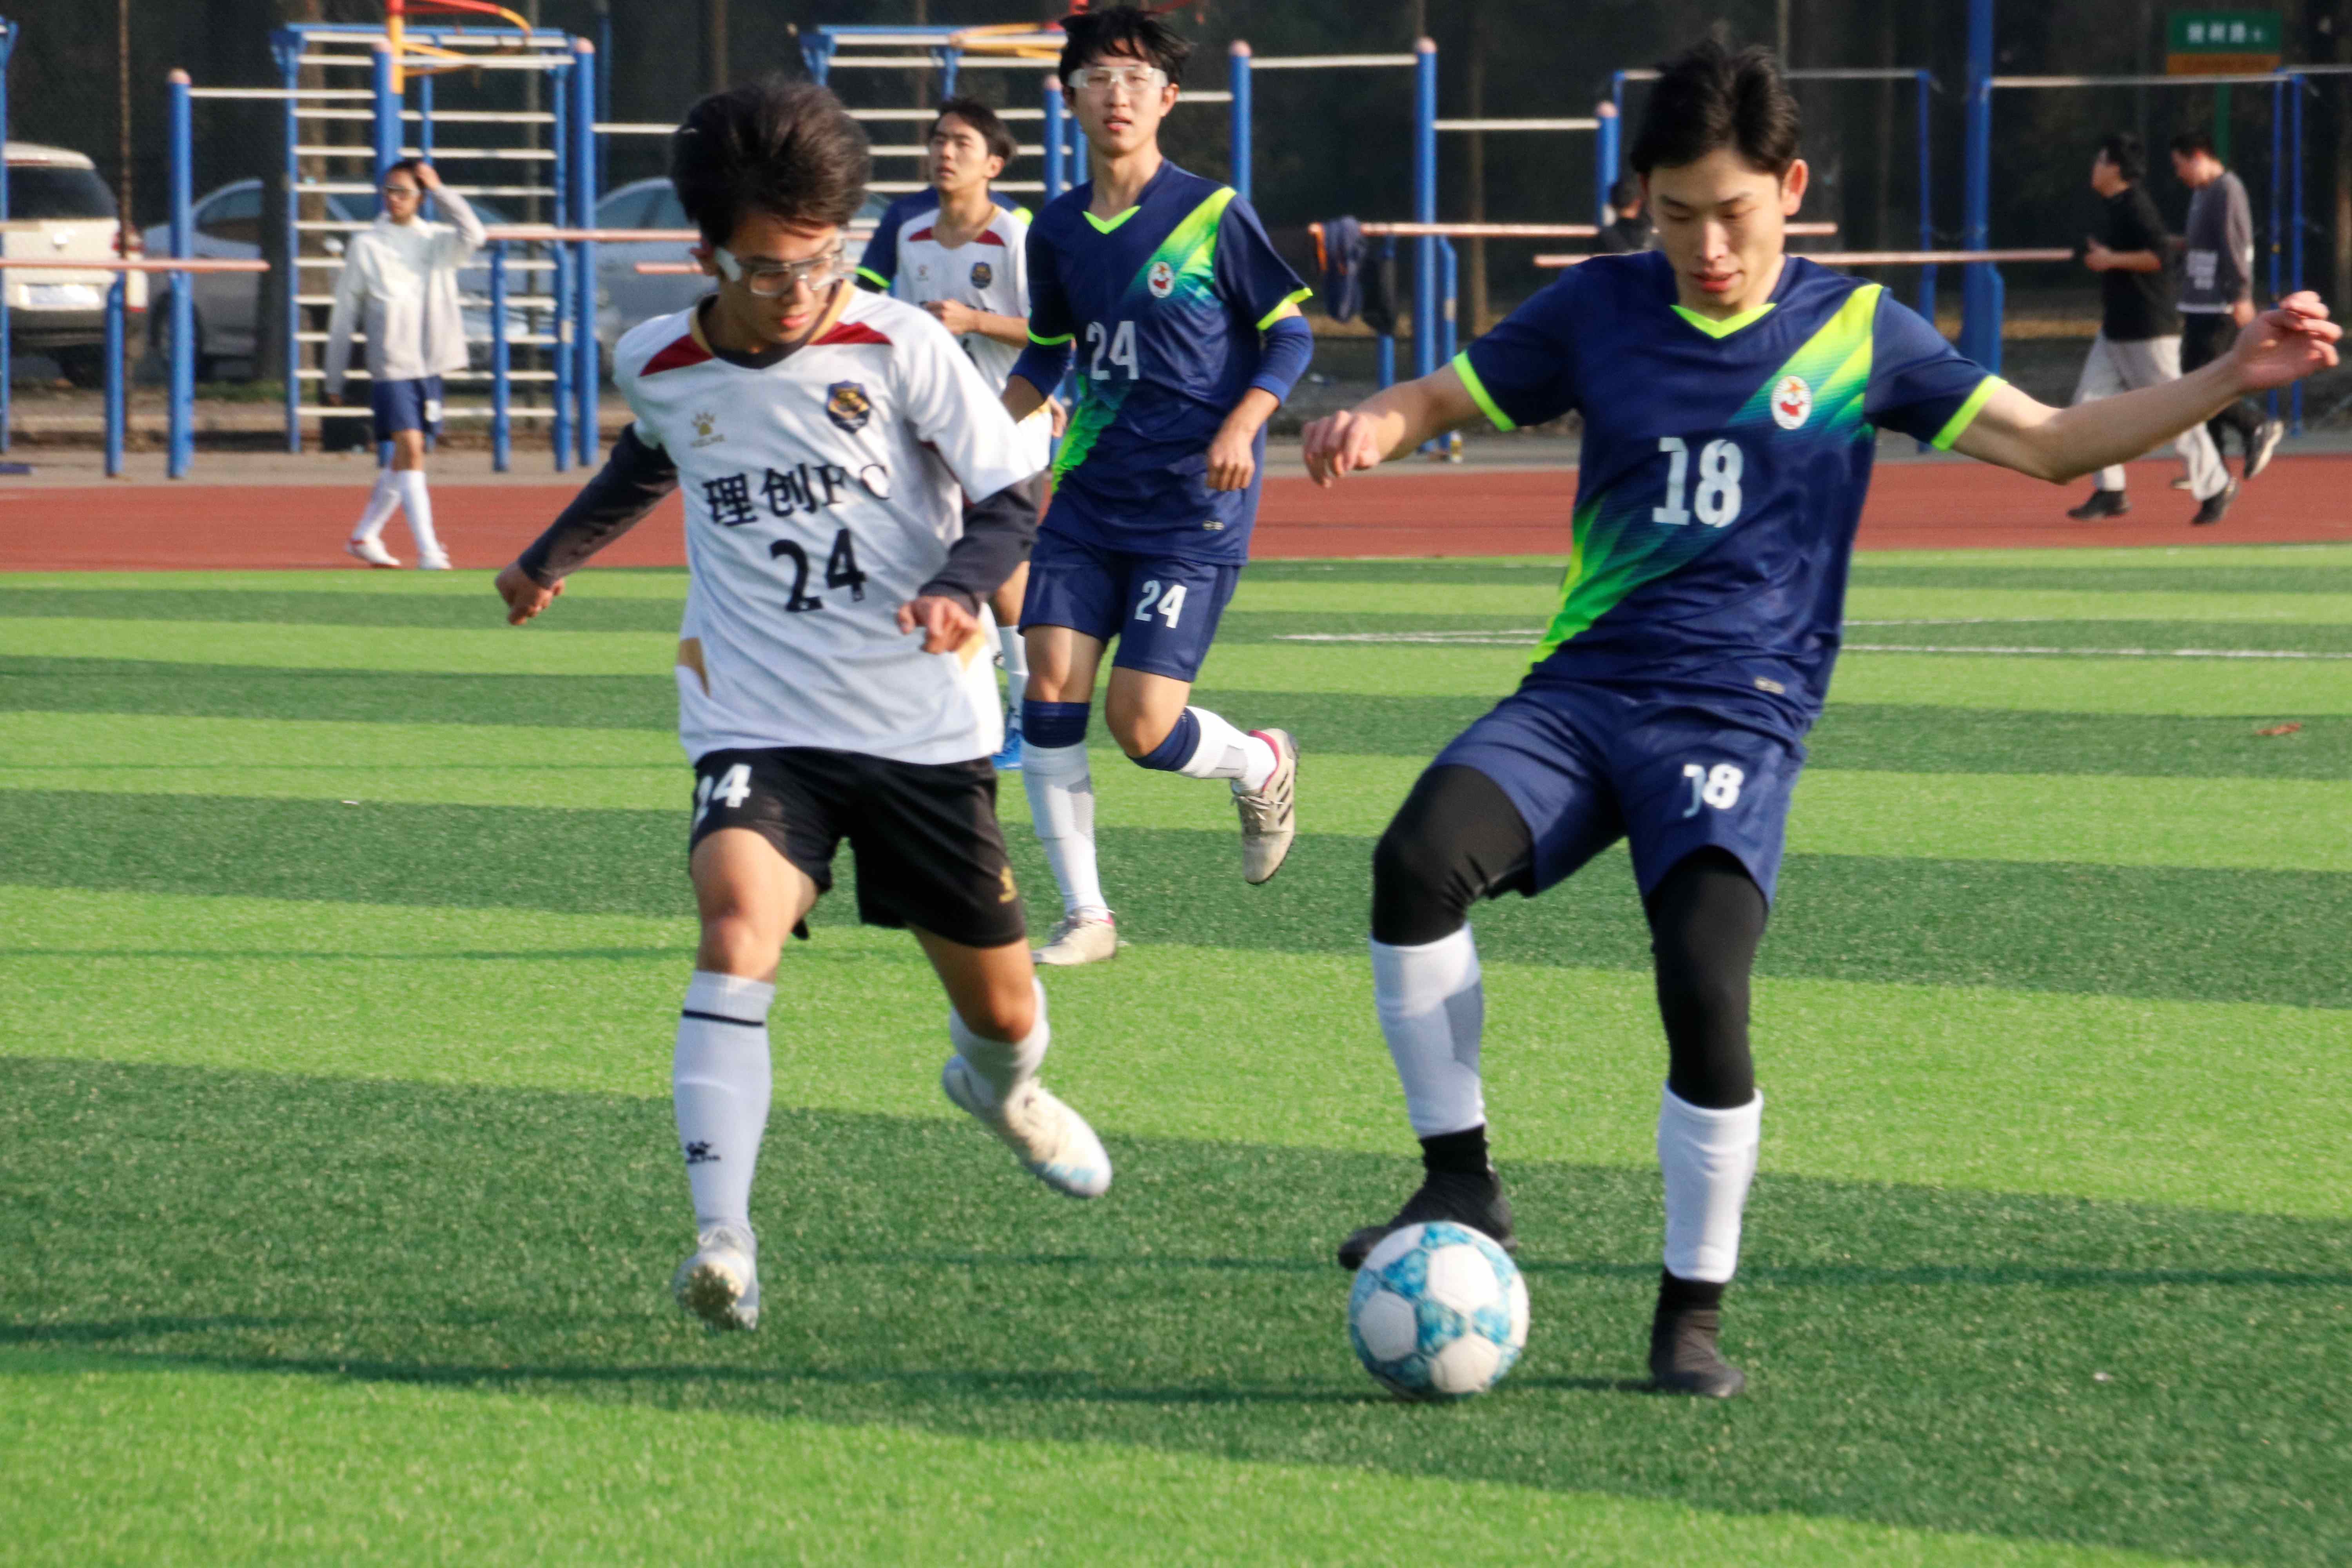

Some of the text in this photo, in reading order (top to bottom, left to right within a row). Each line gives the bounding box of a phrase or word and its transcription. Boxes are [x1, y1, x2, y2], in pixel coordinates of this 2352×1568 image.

[1086, 320, 1139, 380] 24
[702, 463, 889, 526] 理创FC
[1652, 437, 1744, 527] 18
[769, 528, 867, 612] 24
[1135, 580, 1187, 628] 24
[1683, 763, 1744, 818] 18
